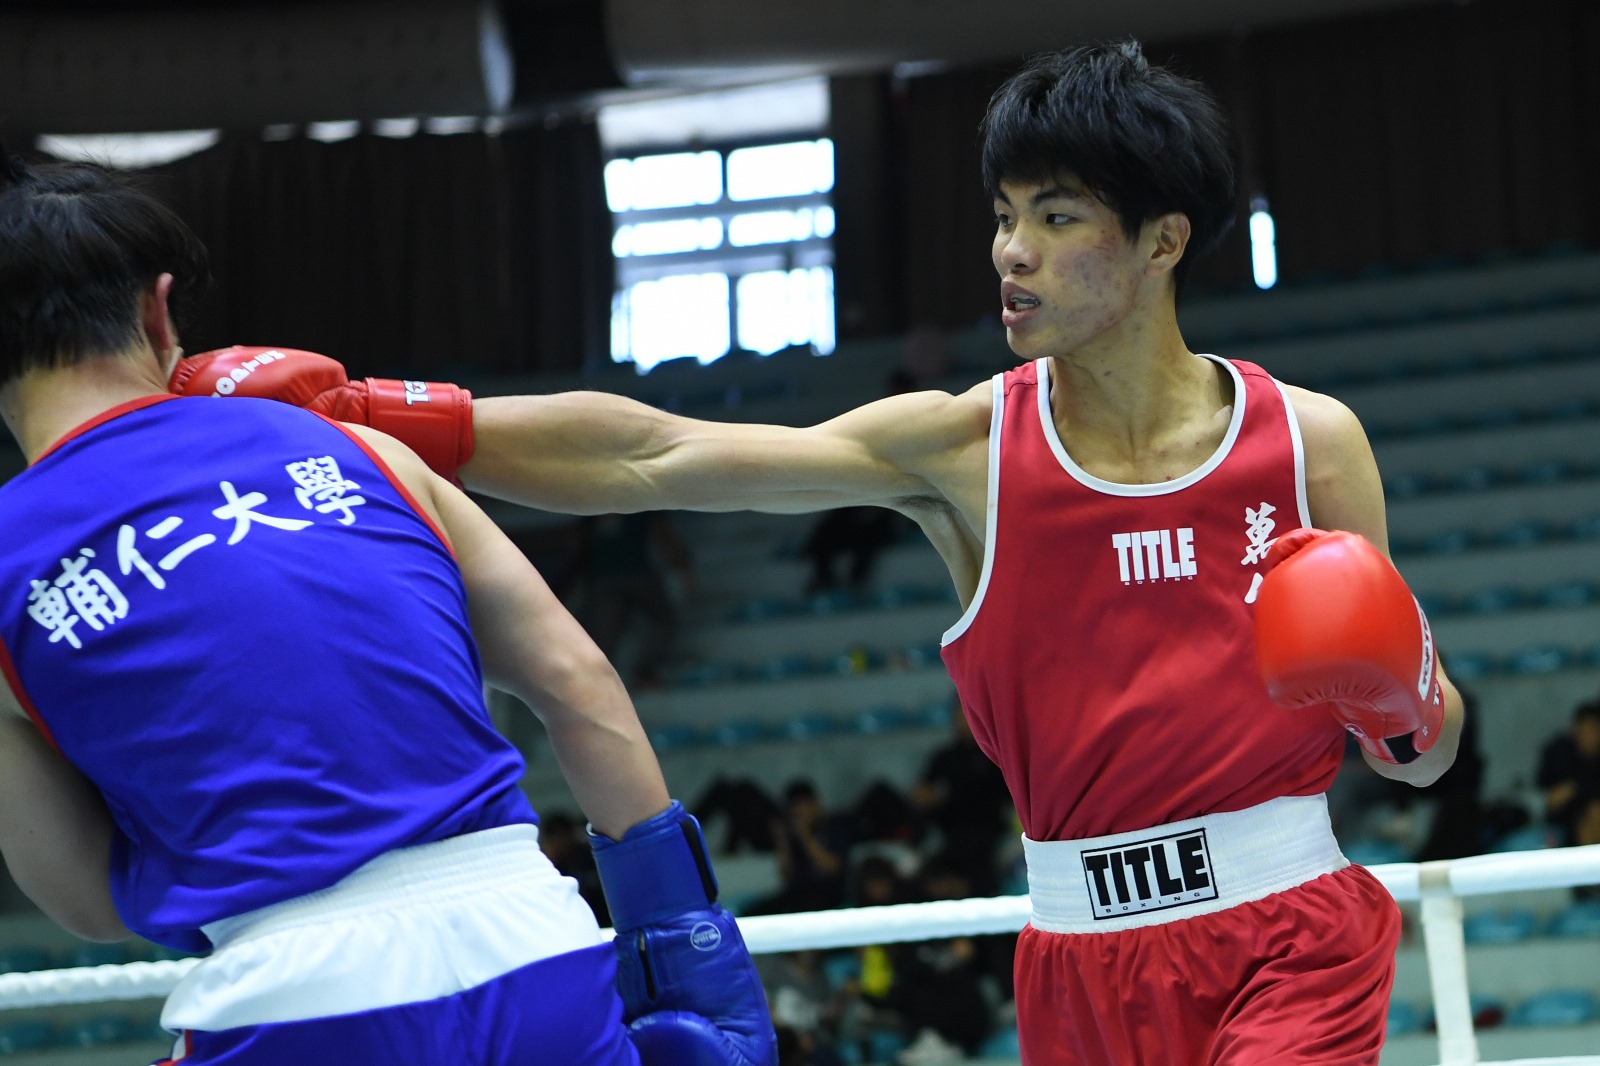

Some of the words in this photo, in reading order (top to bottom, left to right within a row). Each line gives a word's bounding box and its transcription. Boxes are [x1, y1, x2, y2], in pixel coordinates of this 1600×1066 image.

[27, 456, 366, 649] 輔仁大學
[1111, 527, 1198, 582] TITLE
[1240, 501, 1281, 604] 萬
[1085, 835, 1210, 907] TITLE
[1105, 892, 1201, 913] BOXING
